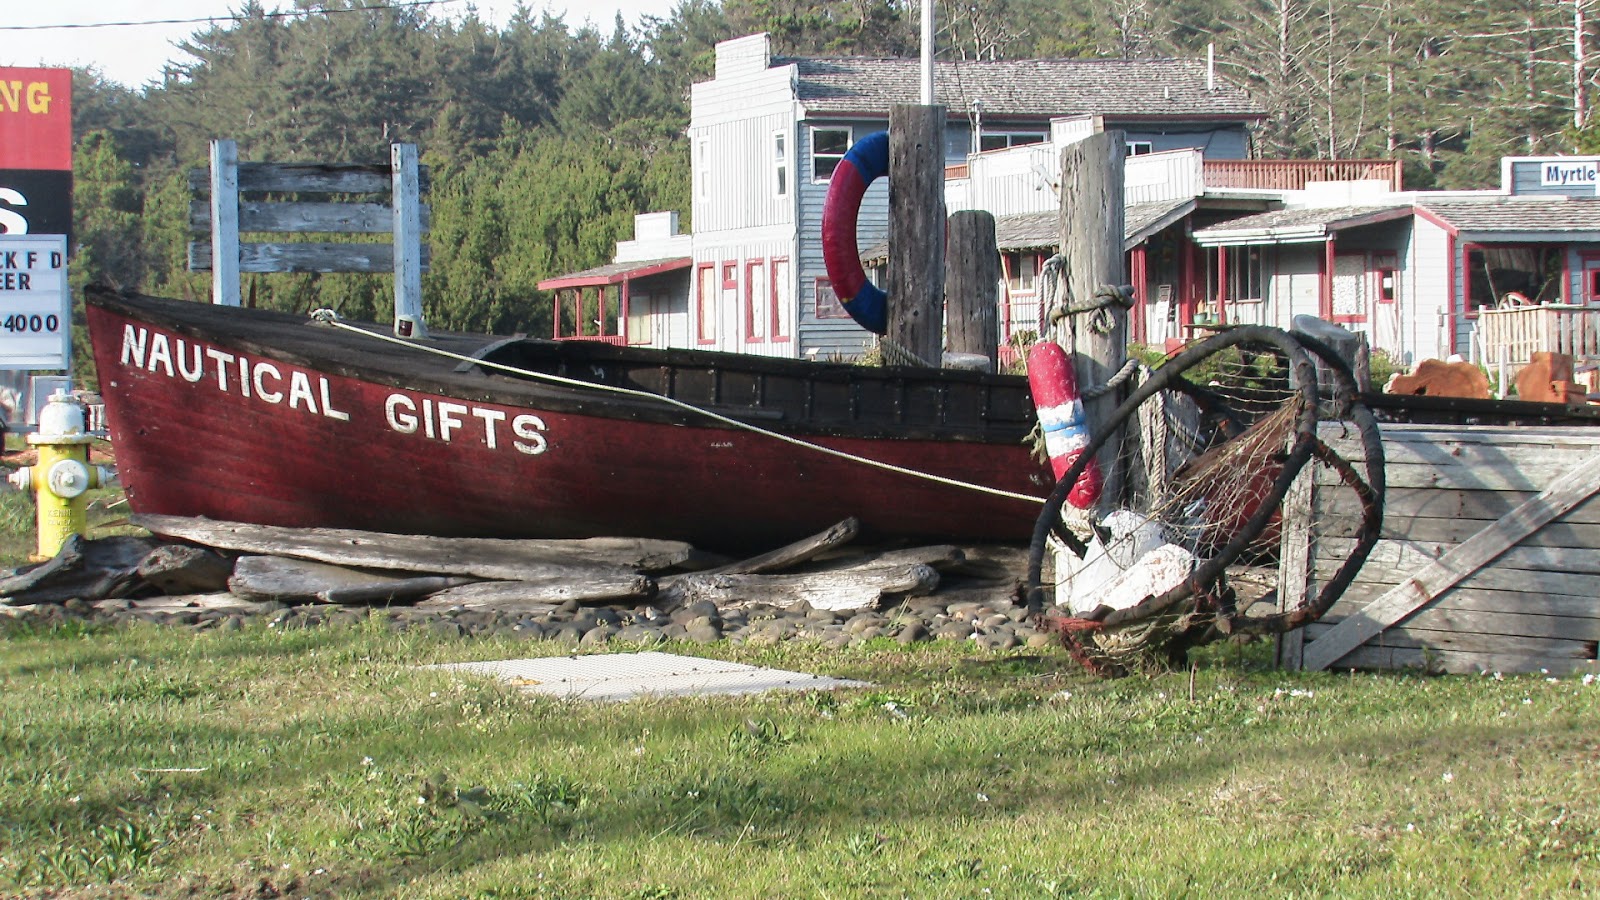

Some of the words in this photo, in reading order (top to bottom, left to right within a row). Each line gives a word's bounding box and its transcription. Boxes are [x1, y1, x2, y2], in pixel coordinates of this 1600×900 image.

[0, 80, 51, 114] NG
[1547, 166, 1595, 184] Myrtle
[120, 324, 350, 421] NAUTICAL
[385, 393, 547, 455] GIFTS
